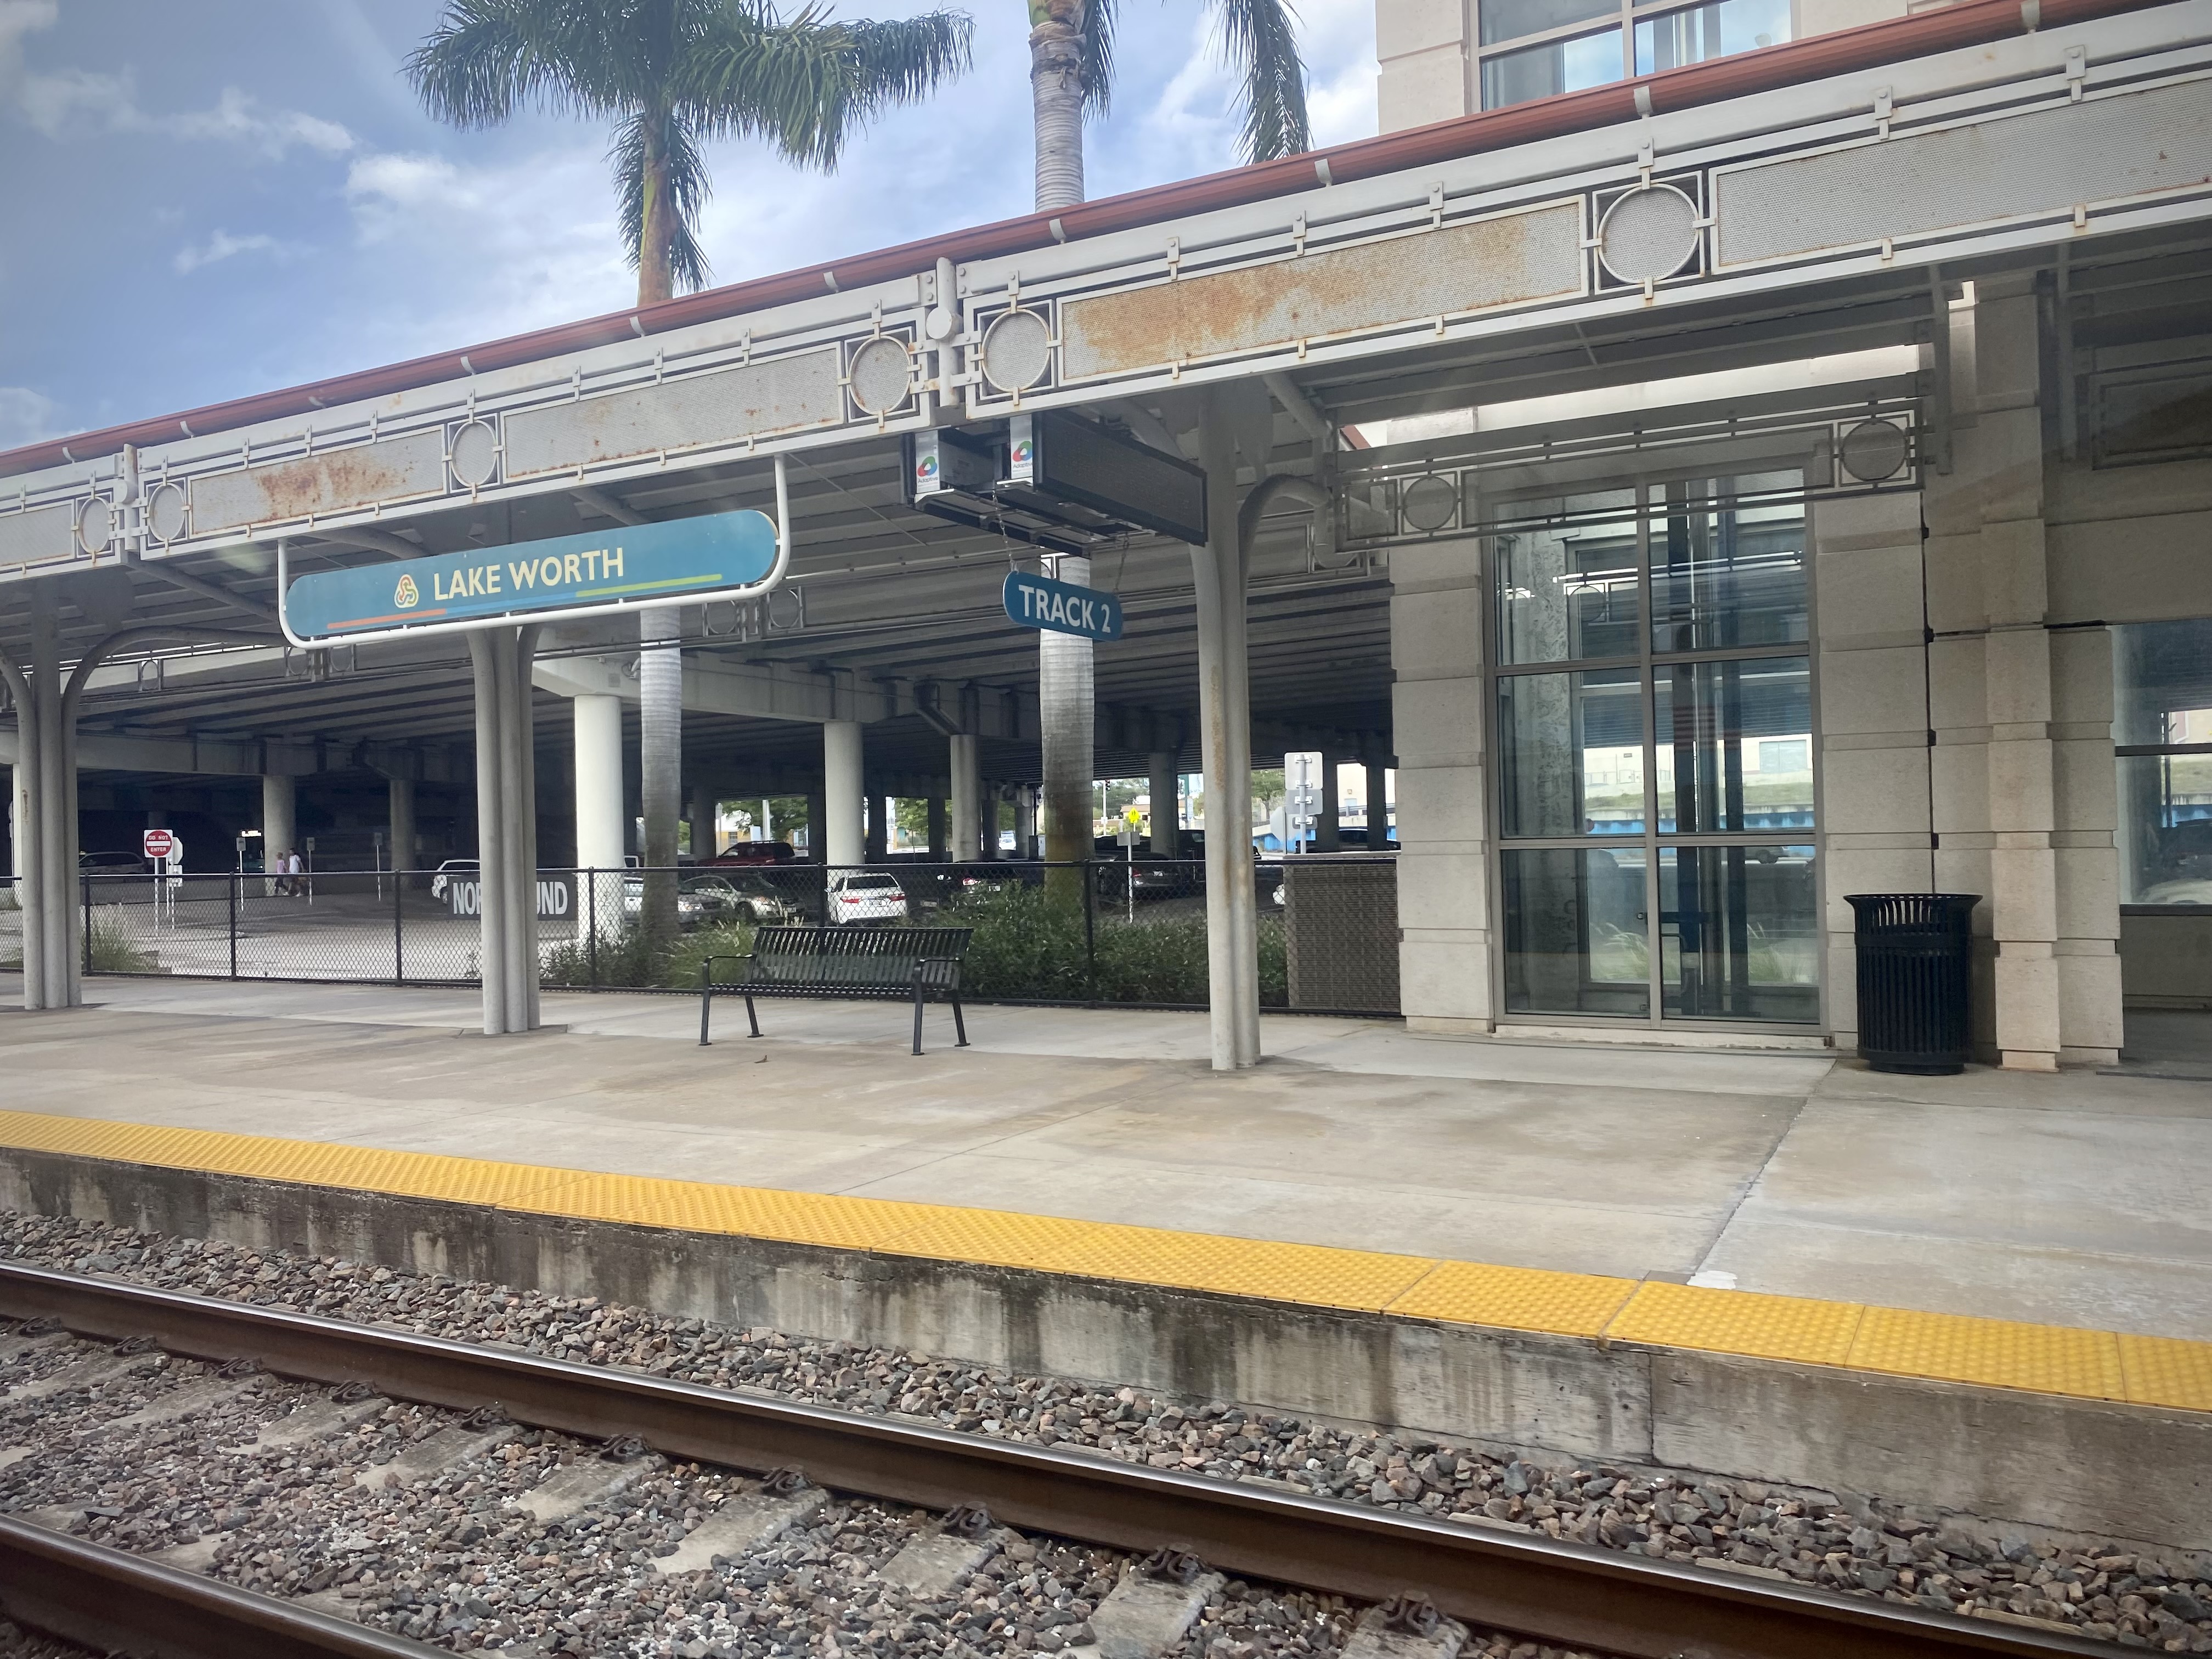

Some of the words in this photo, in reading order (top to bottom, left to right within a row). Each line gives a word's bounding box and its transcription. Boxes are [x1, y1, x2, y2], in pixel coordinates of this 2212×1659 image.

[433, 564, 501, 601] LAKE
[508, 547, 623, 590] WORTH
[1018, 584, 1096, 630] TRACK
[1101, 603, 1111, 633] 2
